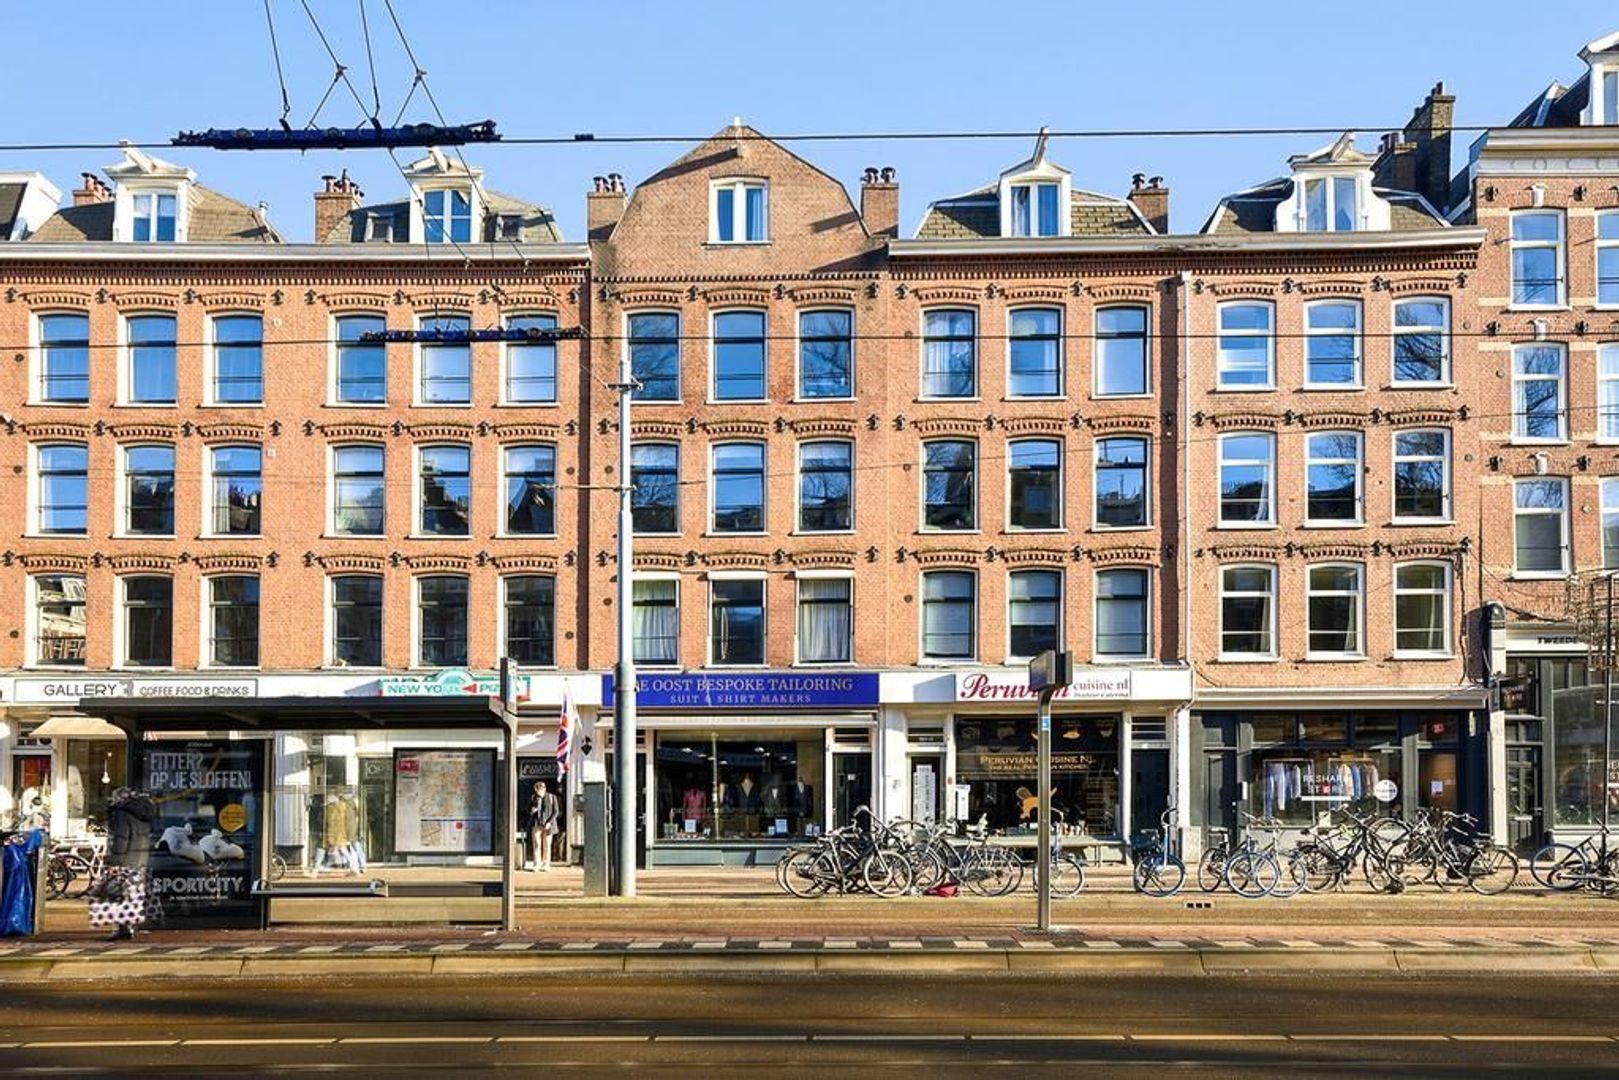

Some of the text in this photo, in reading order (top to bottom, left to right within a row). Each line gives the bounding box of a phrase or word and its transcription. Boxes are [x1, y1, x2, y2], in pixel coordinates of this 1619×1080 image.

[43, 684, 117, 696] GALLERY
[388, 684, 421, 693] NEW
[652, 679, 694, 692] OOST
[697, 678, 765, 692] BESPOKE
[767, 678, 854, 692] TAILORING
[961, 673, 1070, 699] Peruvn
[1073, 678, 1112, 690] cuisine
[140, 686, 250, 696] COFFEE FOOD & DRINKS
[670, 695, 699, 704] SUIT
[717, 695, 755, 703] SHIRT
[761, 694, 812, 703] MAKERS
[151, 752, 204, 770] FITTER?
[150, 770, 252, 790] OP JE SLOFFEN!
